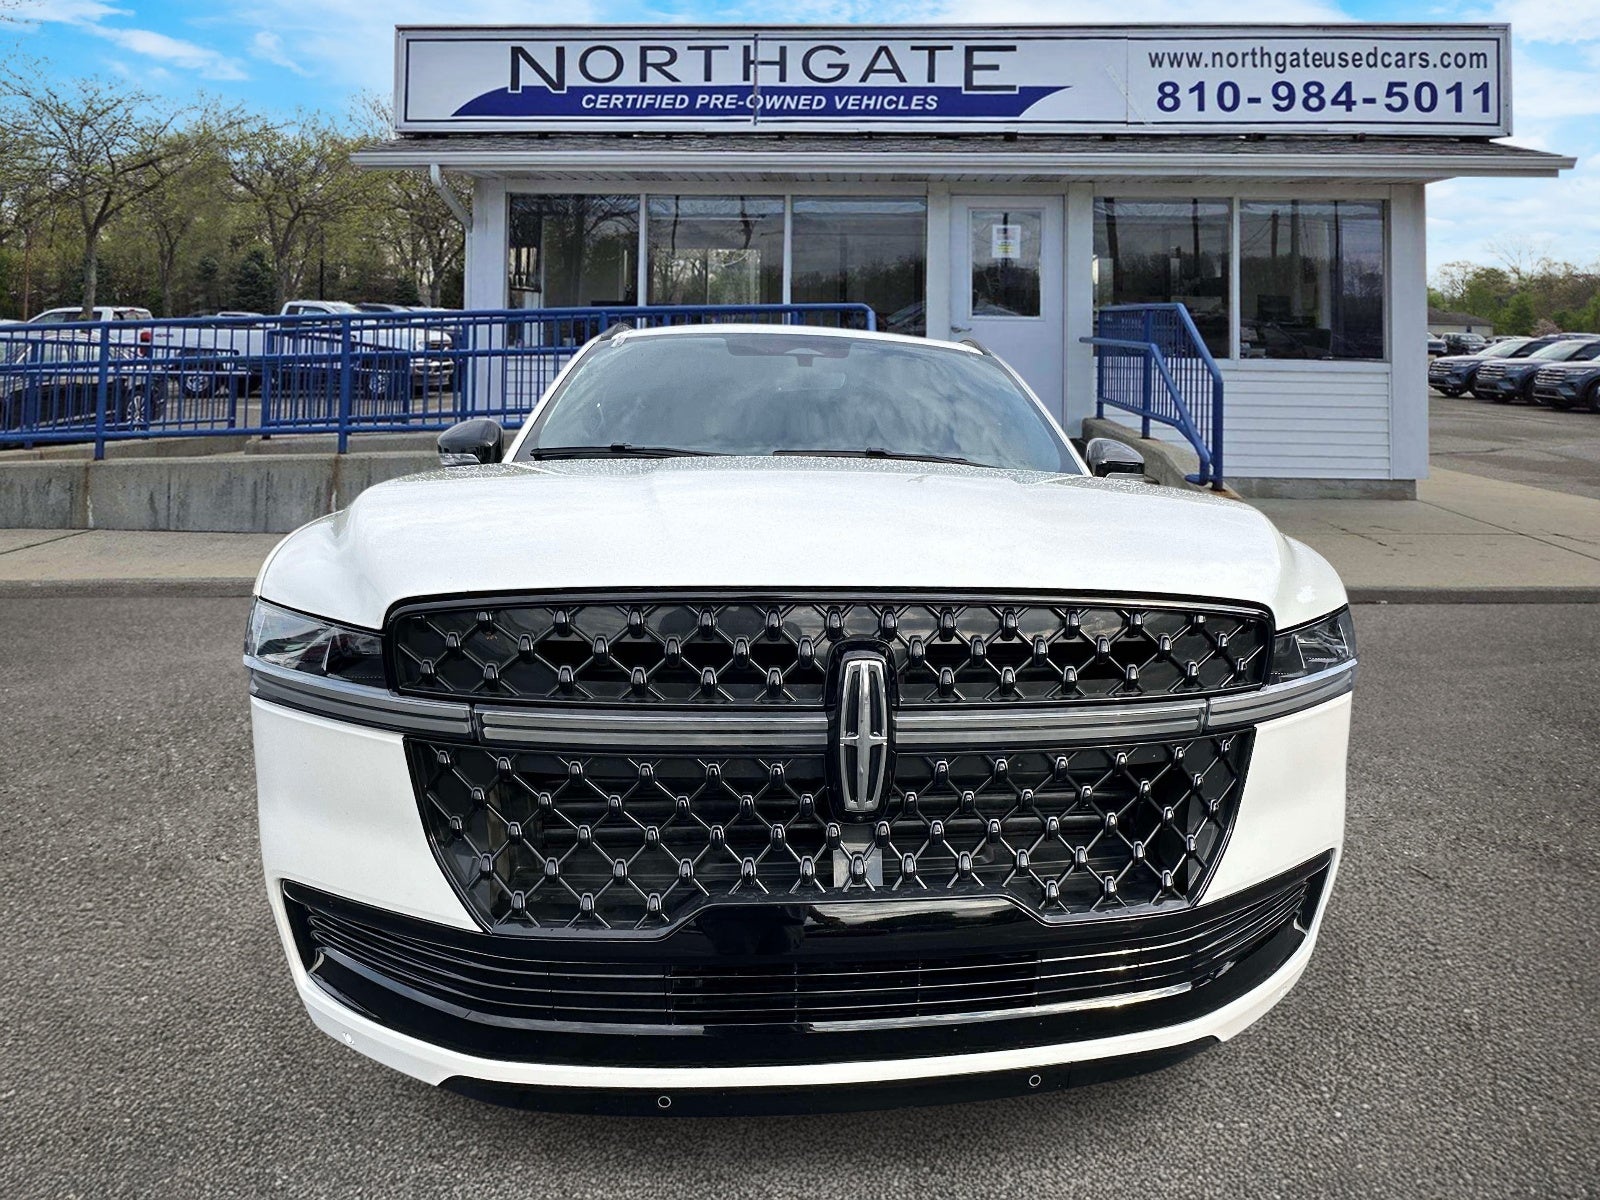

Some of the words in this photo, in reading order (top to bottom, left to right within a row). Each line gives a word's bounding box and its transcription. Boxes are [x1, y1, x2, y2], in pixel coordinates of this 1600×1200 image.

[509, 44, 1017, 92] NORTHGATE
[1148, 46, 1488, 74] www.northgateusedcars.com
[581, 94, 690, 110] CERTIFIED
[695, 94, 827, 110] PRE-OWNED
[834, 94, 939, 110] VEHICLES
[1156, 80, 1491, 113] 810-984-5011
